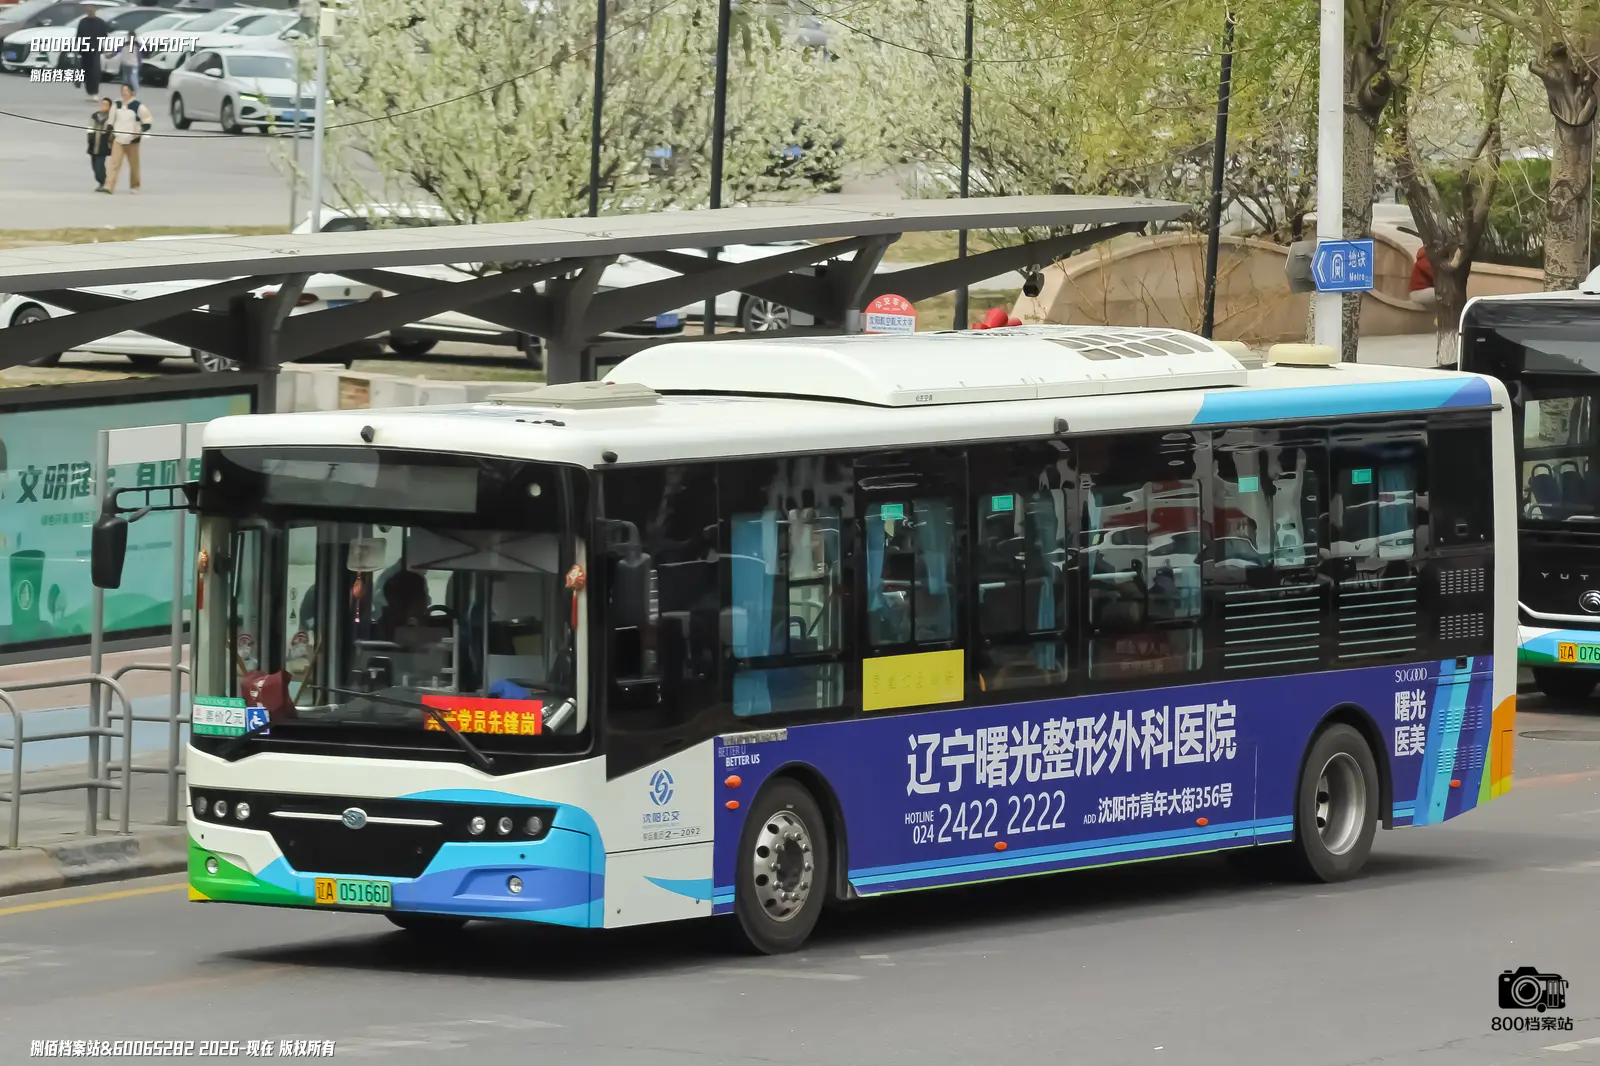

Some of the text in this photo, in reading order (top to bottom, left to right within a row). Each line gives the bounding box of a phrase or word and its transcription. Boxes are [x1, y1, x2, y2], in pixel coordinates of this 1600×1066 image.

[1394, 688, 1427, 722] 曙光
[906, 700, 1237, 796] 辽宁曙光整形外科医院
[1394, 723, 1426, 757] 医美
[725, 754, 760, 767] BETTER US
[904, 810, 934, 825] HOTLINE
[913, 790, 1066, 845] 024 2422 2222
[1083, 782, 1233, 825] ADD 沈阳市青年大街356号
[340, 883, 390, 903] 05166D
